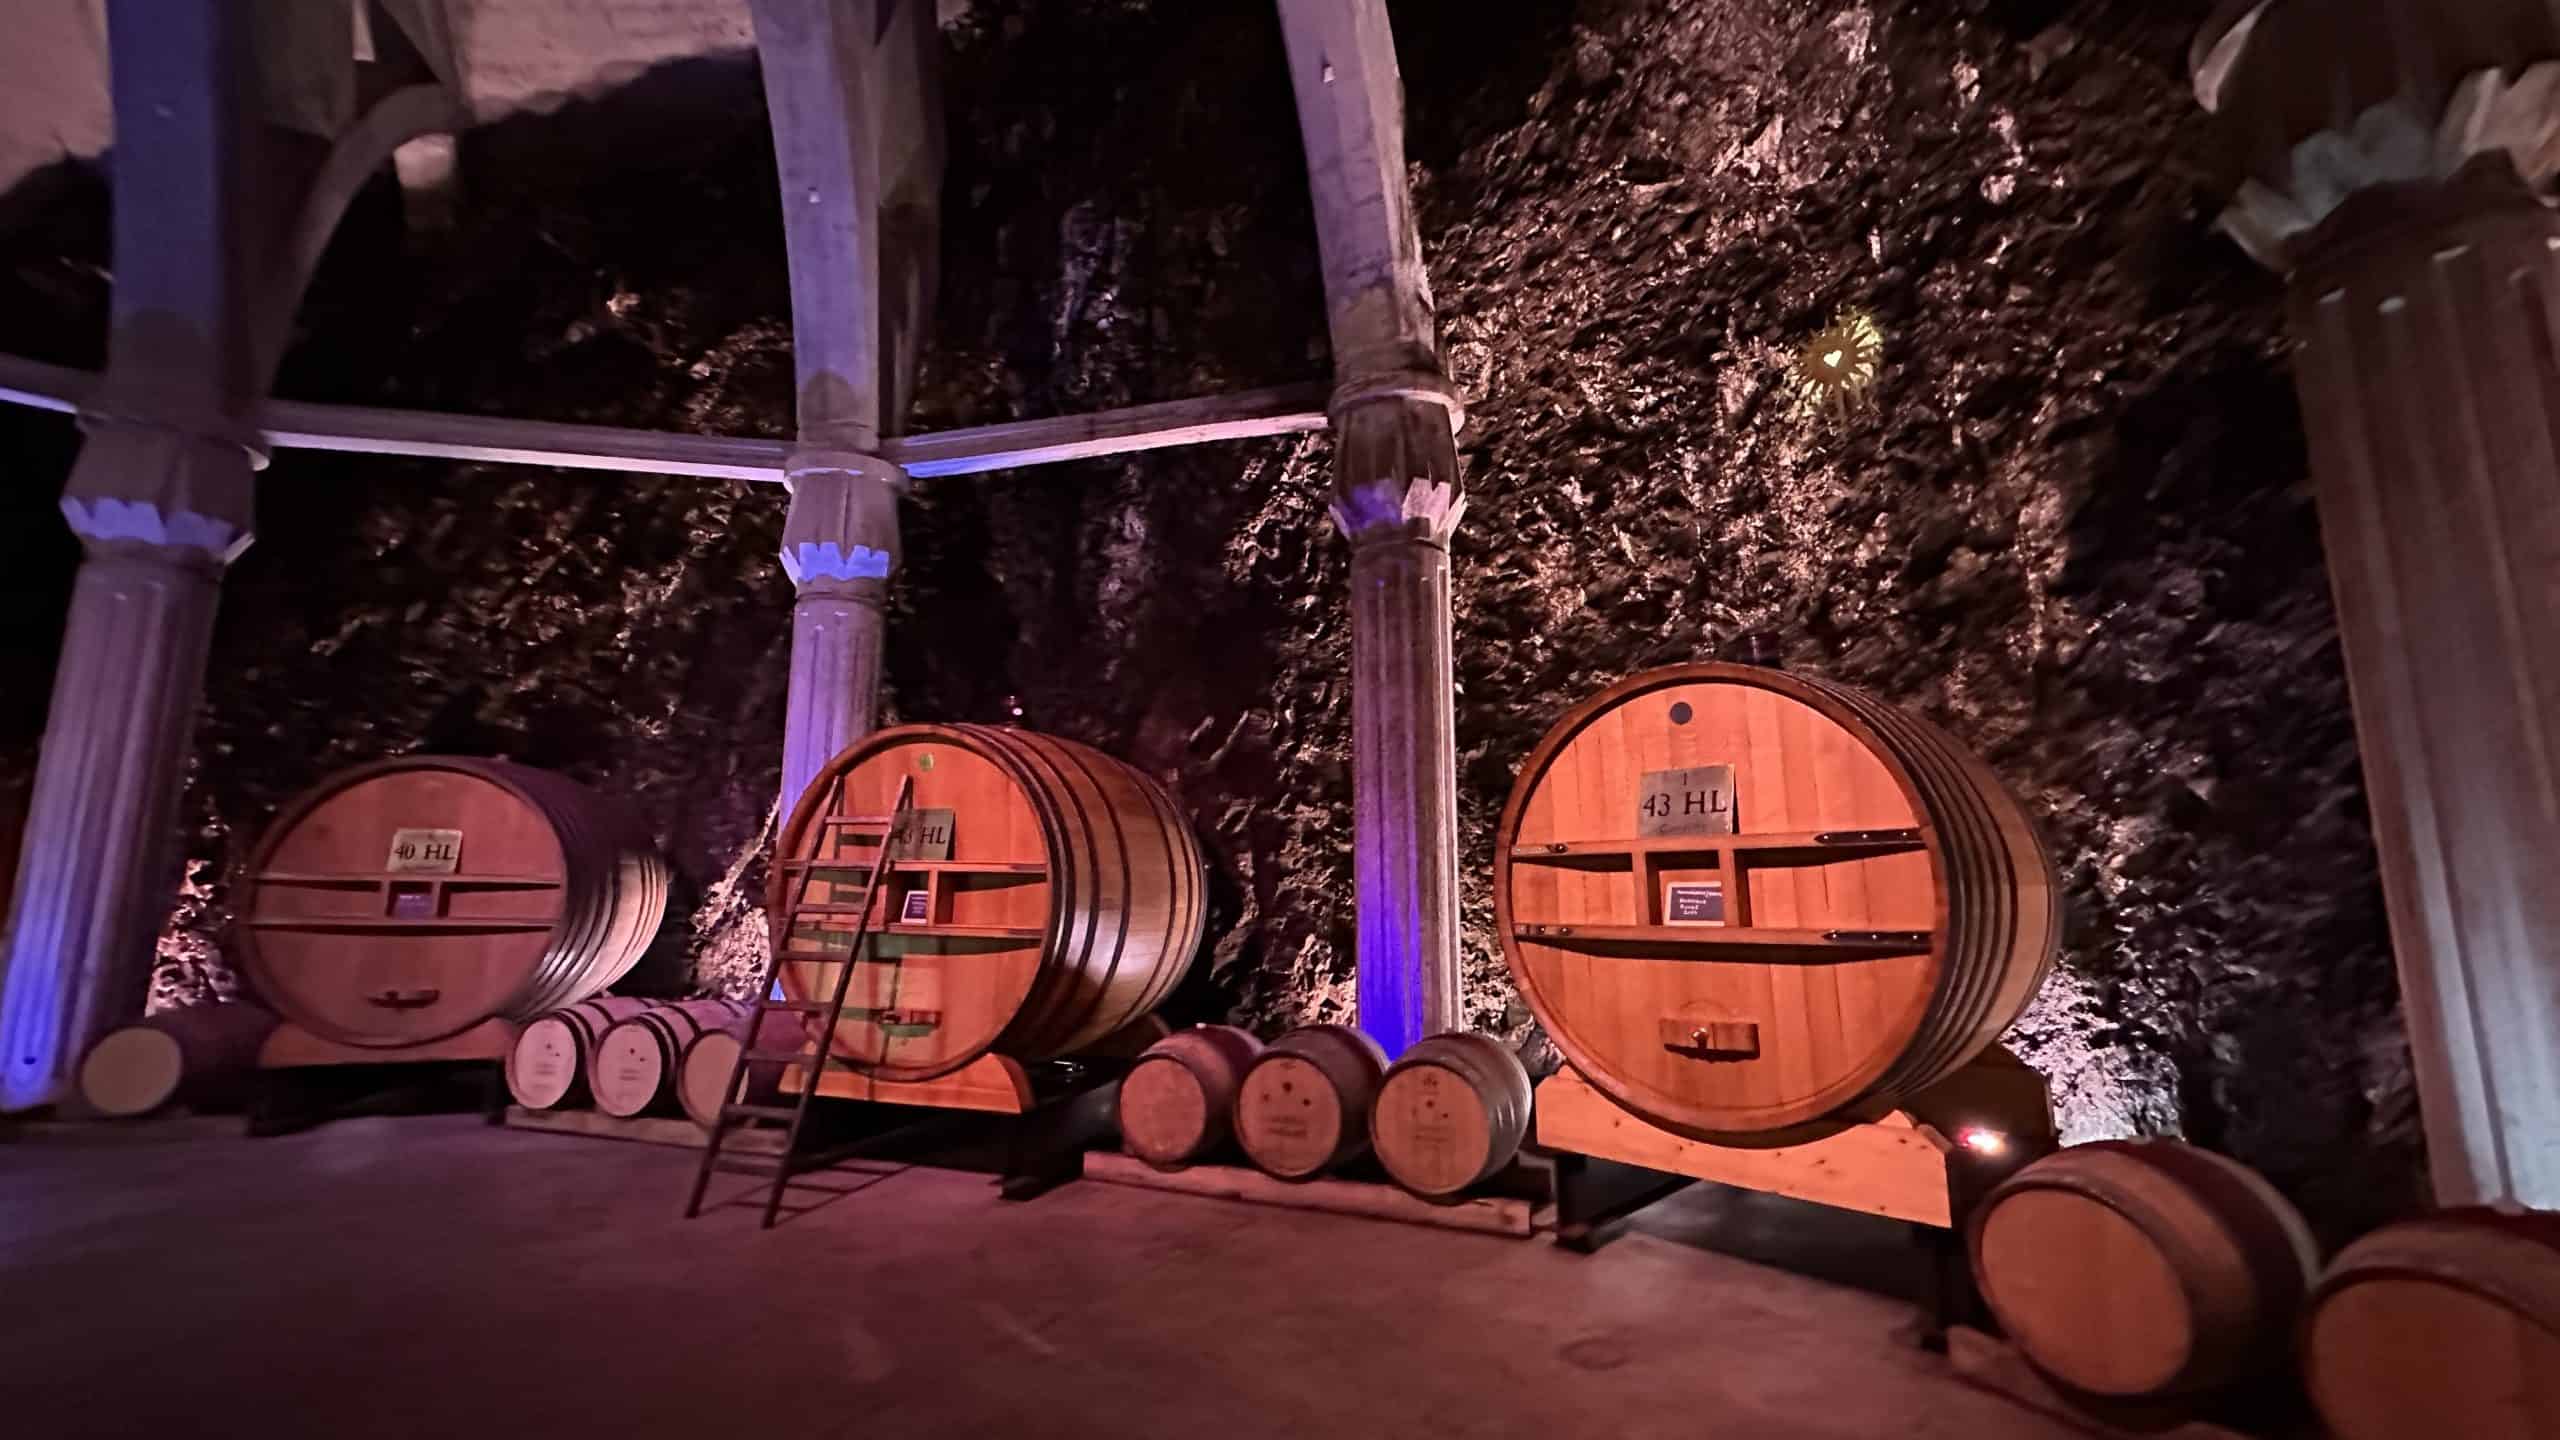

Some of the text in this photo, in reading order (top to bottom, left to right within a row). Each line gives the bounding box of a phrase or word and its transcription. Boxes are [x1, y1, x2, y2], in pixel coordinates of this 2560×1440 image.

[1642, 789, 1728, 817] 43 HL
[920, 825, 946, 844] HL
[394, 843, 455, 860] 40 HL
